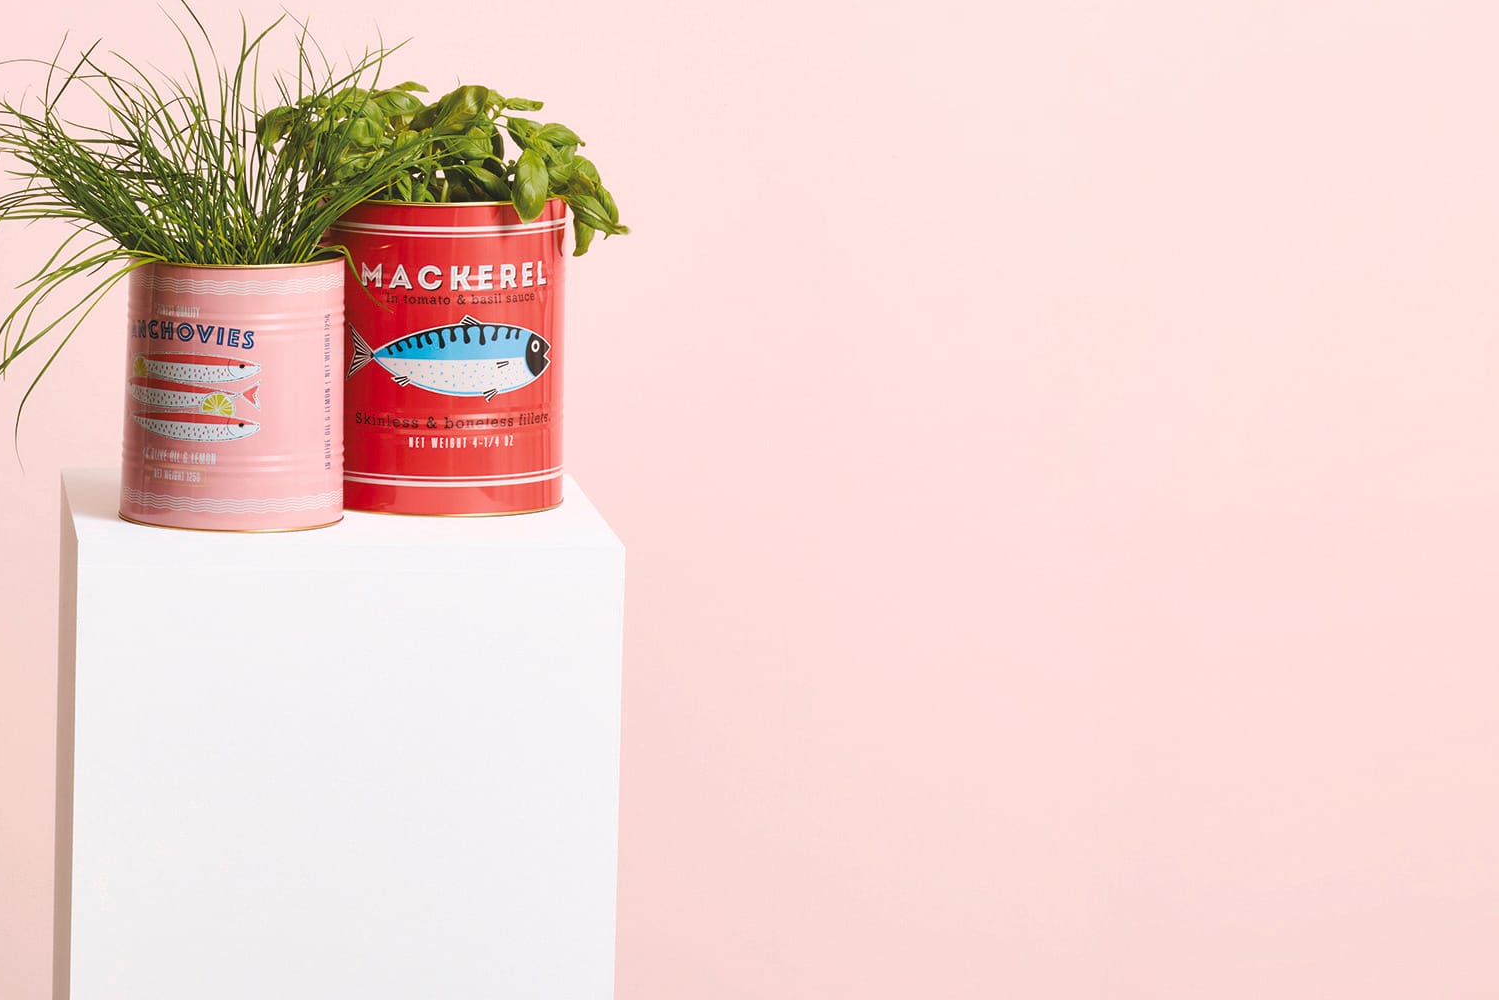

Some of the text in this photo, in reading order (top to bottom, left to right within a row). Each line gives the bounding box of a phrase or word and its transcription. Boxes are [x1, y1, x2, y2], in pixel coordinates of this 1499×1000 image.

[361, 261, 547, 291] MACKEREL
[386, 291, 536, 306] In tomato & basil sauce
[132, 320, 255, 349] ANCHOVIES
[355, 411, 419, 429] Skinless
[426, 416, 437, 429] &
[444, 416, 514, 429] boneless
[408, 434, 515, 449] NET WEIGHT 4-1/4 OZ
[191, 452, 217, 465] LEMON
